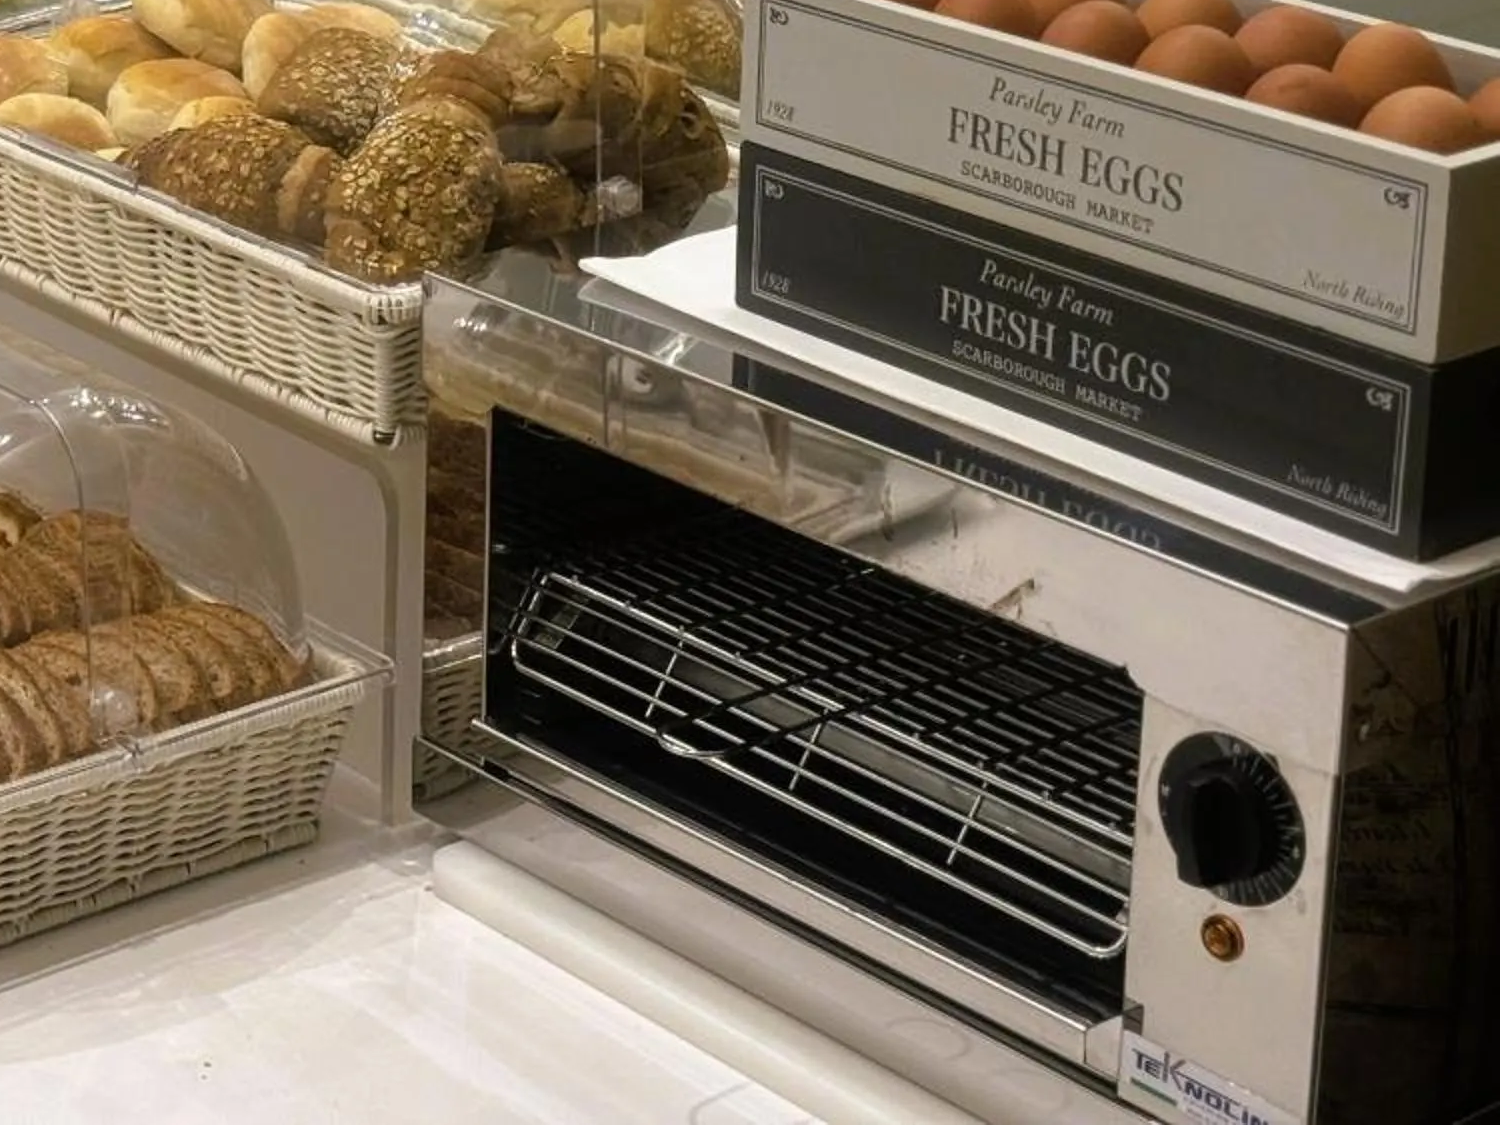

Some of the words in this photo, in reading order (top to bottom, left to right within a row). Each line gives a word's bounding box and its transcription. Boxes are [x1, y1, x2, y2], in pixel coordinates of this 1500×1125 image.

[989, 76, 1063, 125] Parsley
[1067, 99, 1126, 138] Farm
[947, 106, 1068, 176] FRESH
[1079, 144, 1185, 213] EGGS
[960, 160, 1077, 210] SCARBOROUGH
[1086, 200, 1155, 235] MARKET
[979, 258, 1053, 309] Parsley
[1056, 283, 1115, 326] Farm
[1303, 268, 1349, 298] North
[939, 285, 1057, 361] FRESH
[1068, 330, 1172, 401] EGGS
[952, 340, 1067, 395] SCARBOROUGH
[1075, 384, 1144, 422] MARKET
[1286, 463, 1333, 494] North
